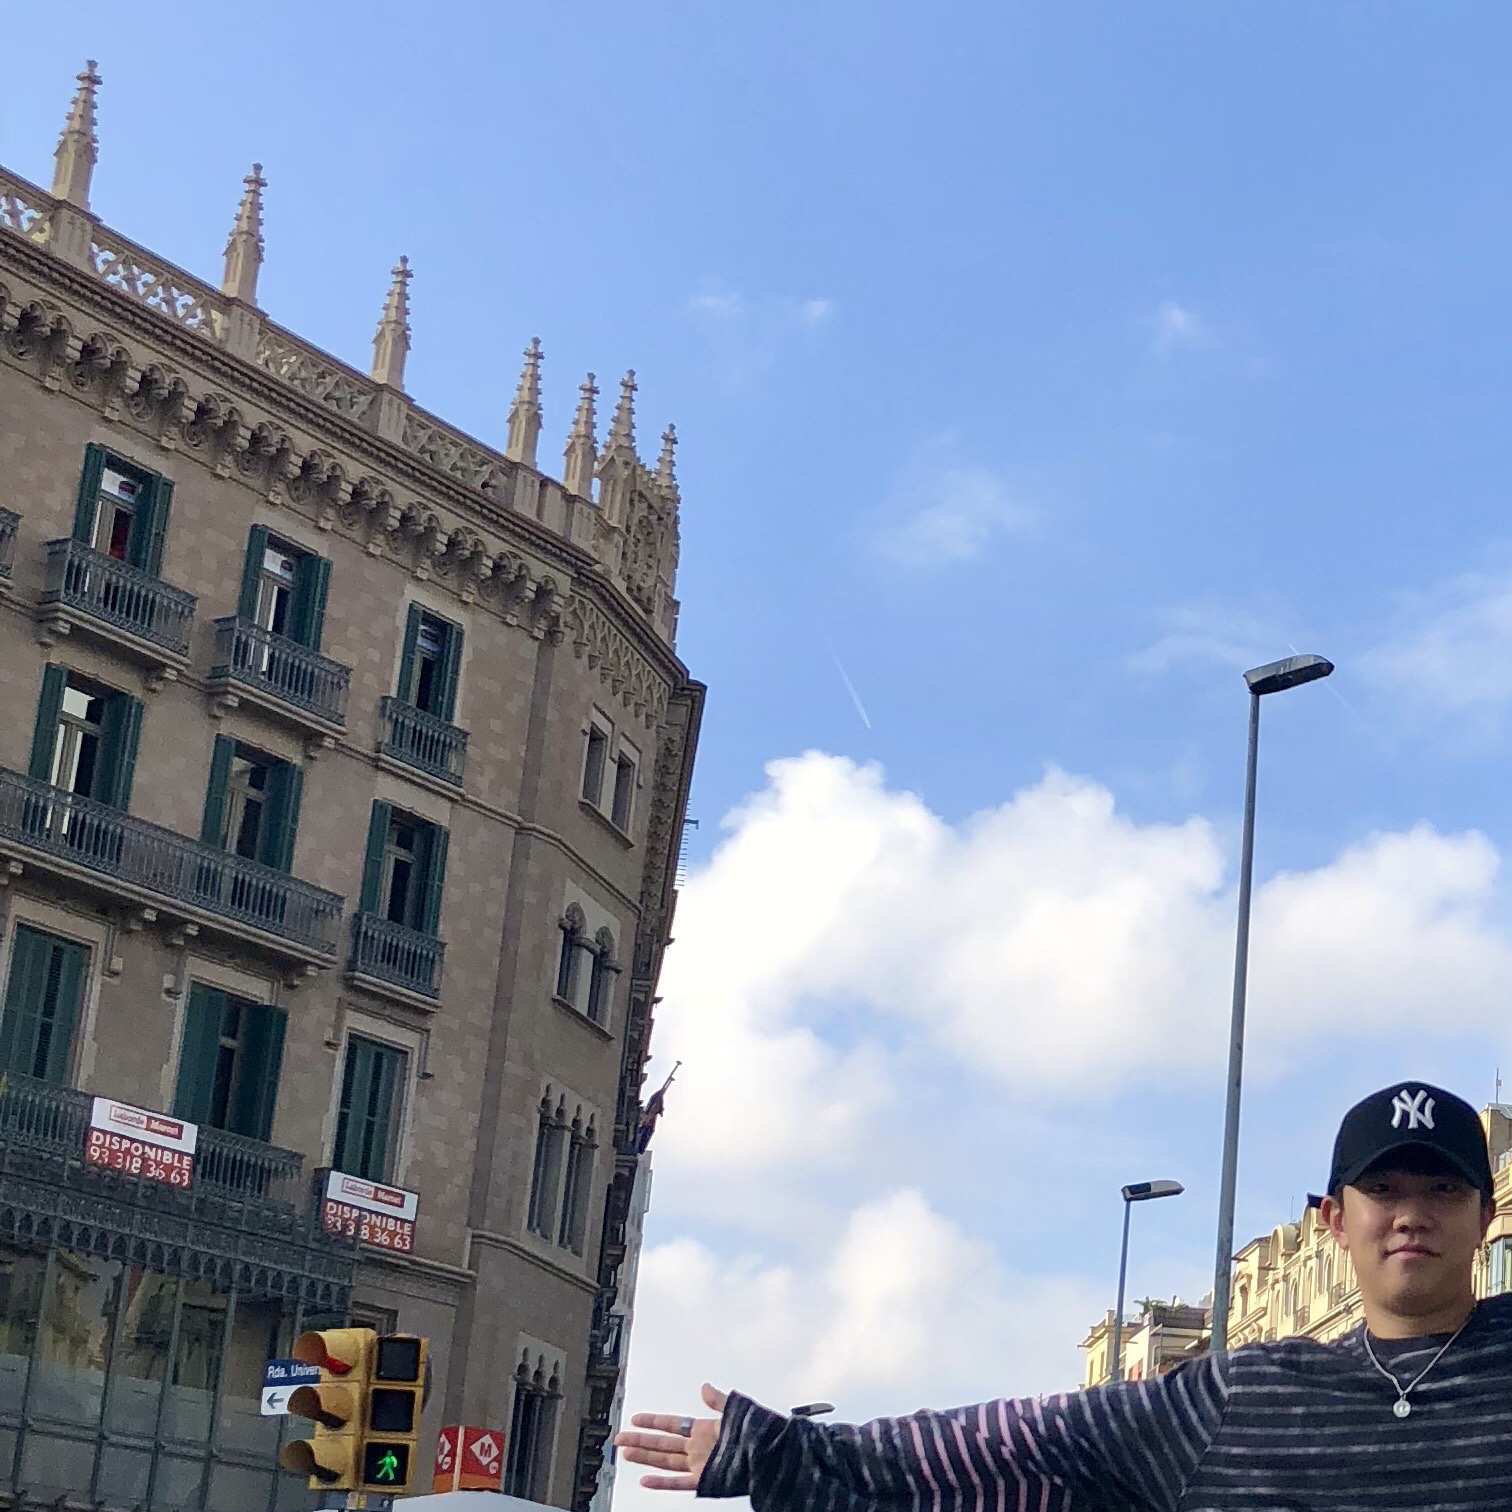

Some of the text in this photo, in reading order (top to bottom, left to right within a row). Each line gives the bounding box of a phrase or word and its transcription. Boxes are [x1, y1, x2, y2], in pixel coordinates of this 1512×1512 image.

[1391, 1089, 1435, 1129] NY
[91, 1131, 193, 1170] DISPONIBLE
[170, 1168, 190, 1187] 63
[326, 1201, 412, 1235] DISPONIBLE
[346, 1220, 370, 1240] 38
